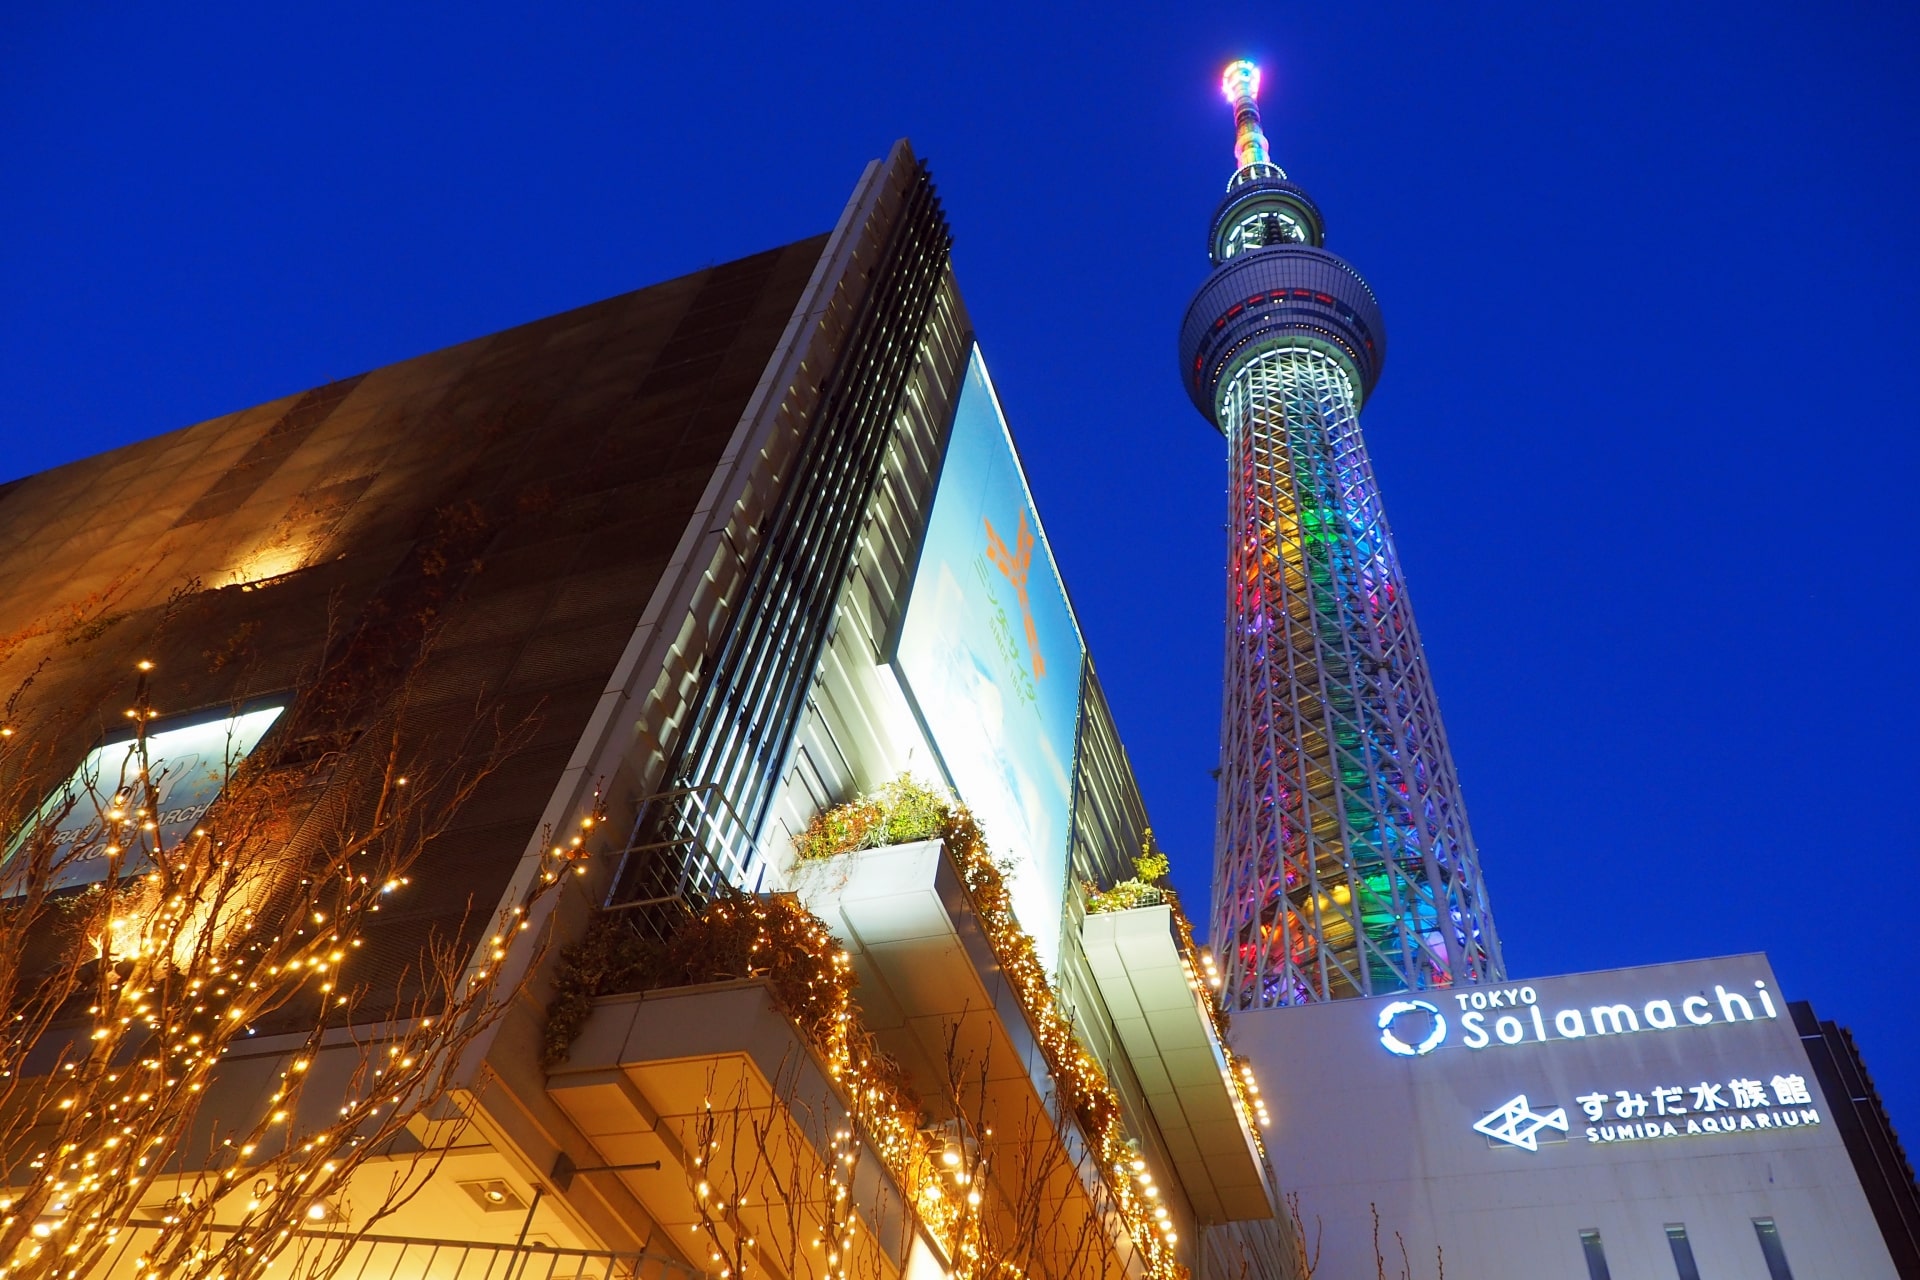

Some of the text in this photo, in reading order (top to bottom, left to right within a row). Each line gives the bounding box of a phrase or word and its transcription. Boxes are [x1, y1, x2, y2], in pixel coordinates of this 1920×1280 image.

[989, 616, 1009, 665] SINCE
[1455, 986, 1537, 1011] TOKYO
[1461, 980, 1778, 1049] Solamachi
[1576, 1073, 1812, 1122] すみだ水族館
[1585, 1109, 1821, 1143] SUMIDA AQUARIUM
